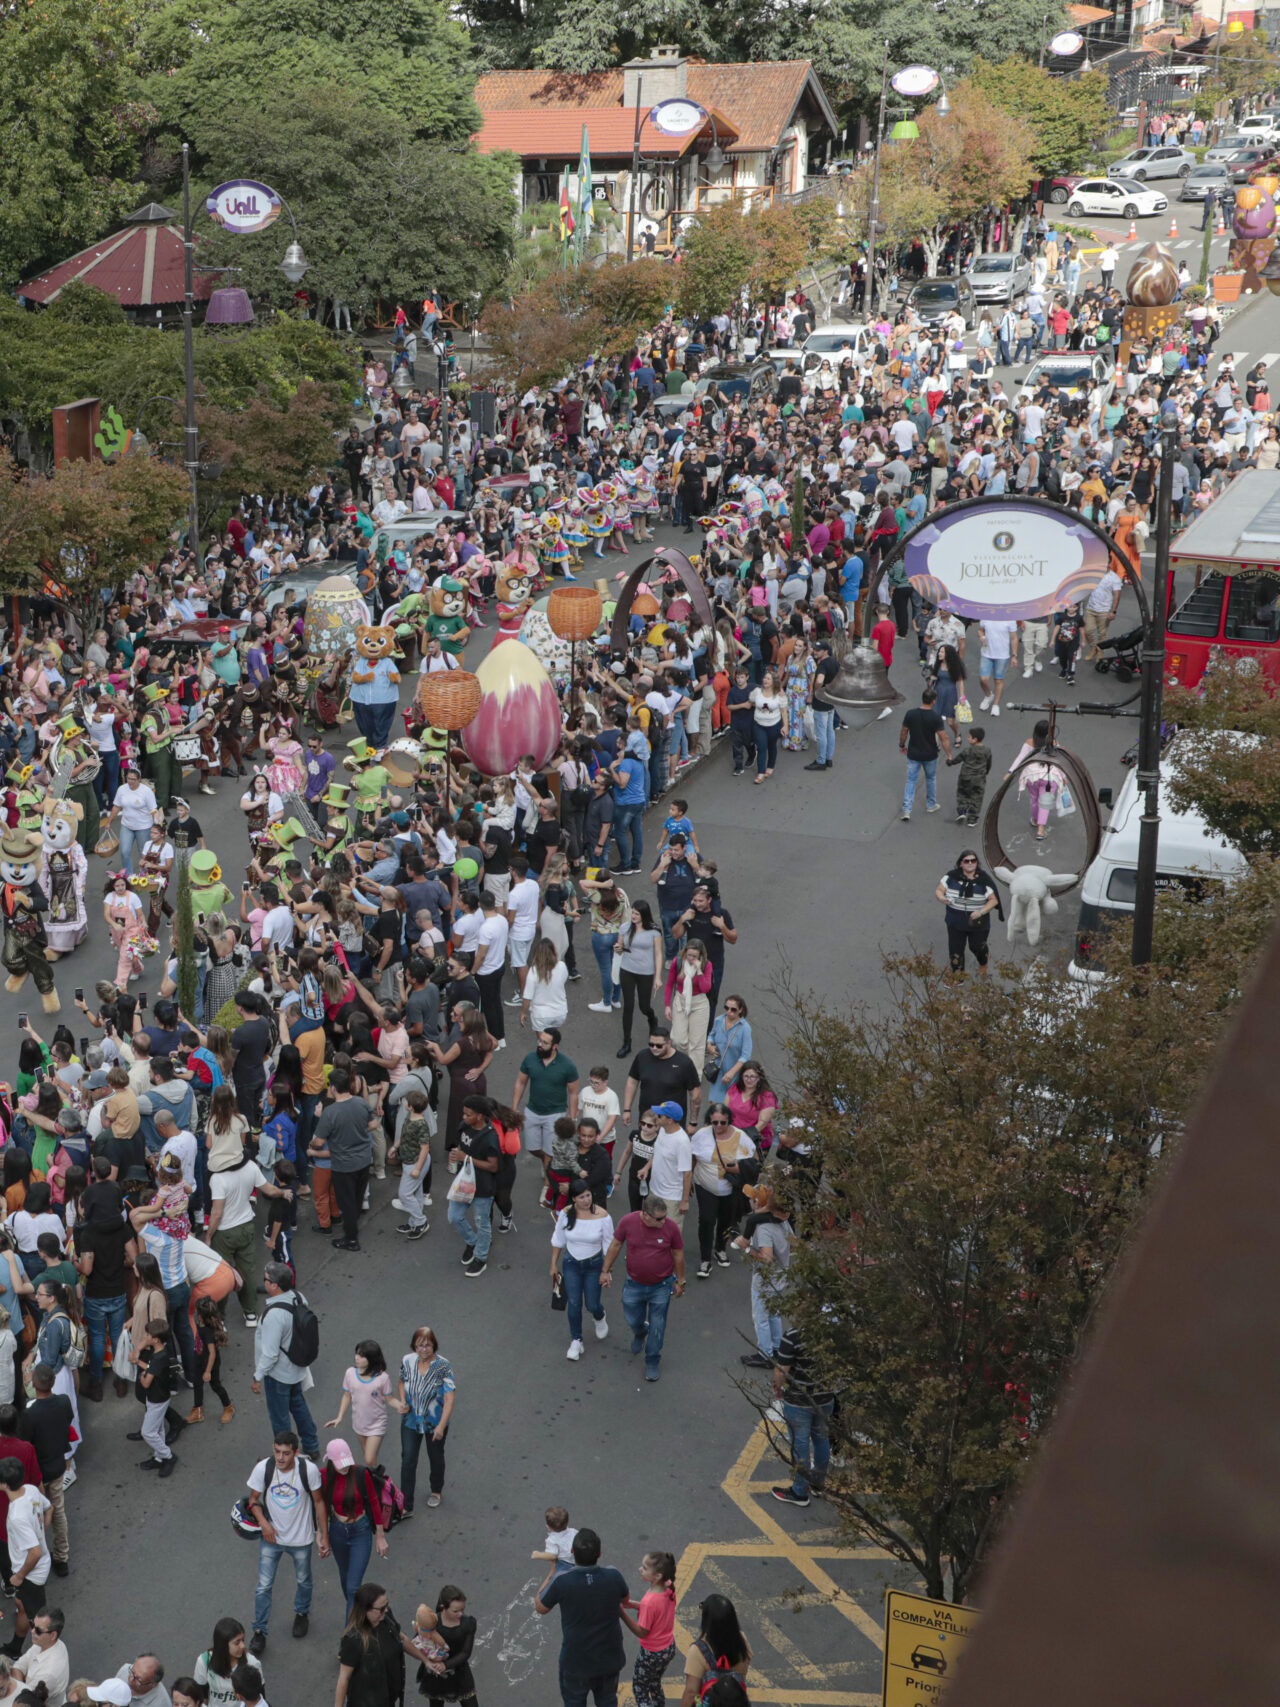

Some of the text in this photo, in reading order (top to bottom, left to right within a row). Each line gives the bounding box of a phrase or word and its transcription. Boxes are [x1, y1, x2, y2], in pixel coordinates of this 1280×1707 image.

[959, 560, 1049, 582] JOLIMONT
[892, 1609, 972, 1636] COMPARTILH
[933, 1609, 953, 1622] VIA
[210, 1690, 241, 1703] refis
